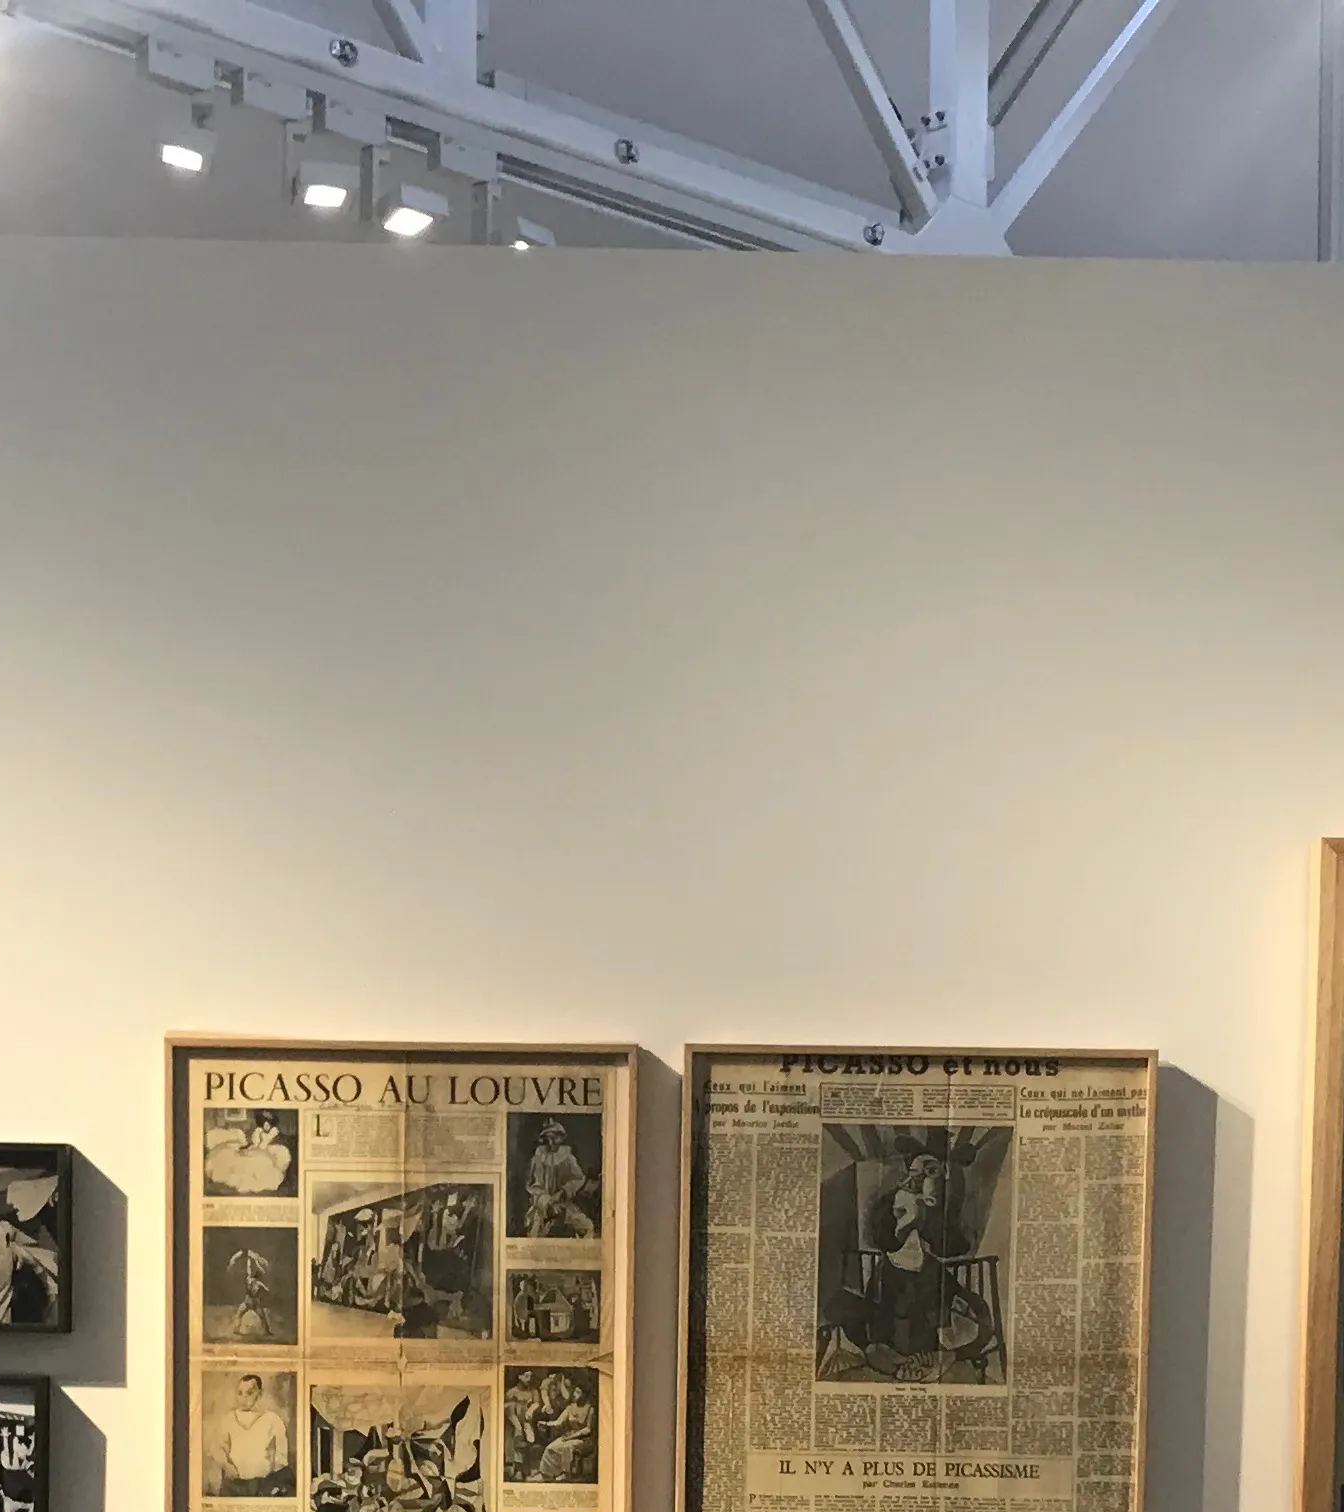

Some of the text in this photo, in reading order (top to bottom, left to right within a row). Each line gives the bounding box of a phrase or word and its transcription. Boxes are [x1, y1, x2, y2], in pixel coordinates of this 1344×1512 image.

[779, 1054, 1059, 1077] PICASSO et nous
[204, 1072, 602, 1106] PICASSO AU LOUVRE
[738, 1082, 756, 1094] qui
[763, 1081, 806, 1093] l'aiment
[1020, 1087, 1045, 1097] Ceux
[1050, 1088, 1067, 1100] qui
[744, 1100, 756, 1113] de
[762, 1101, 821, 1116] l'exposition
[1020, 1105, 1031, 1118] Le
[1091, 1104, 1113, 1118] d'un
[779, 1460, 1040, 1479] IL N'Y A PLUS DE PICASSISME
